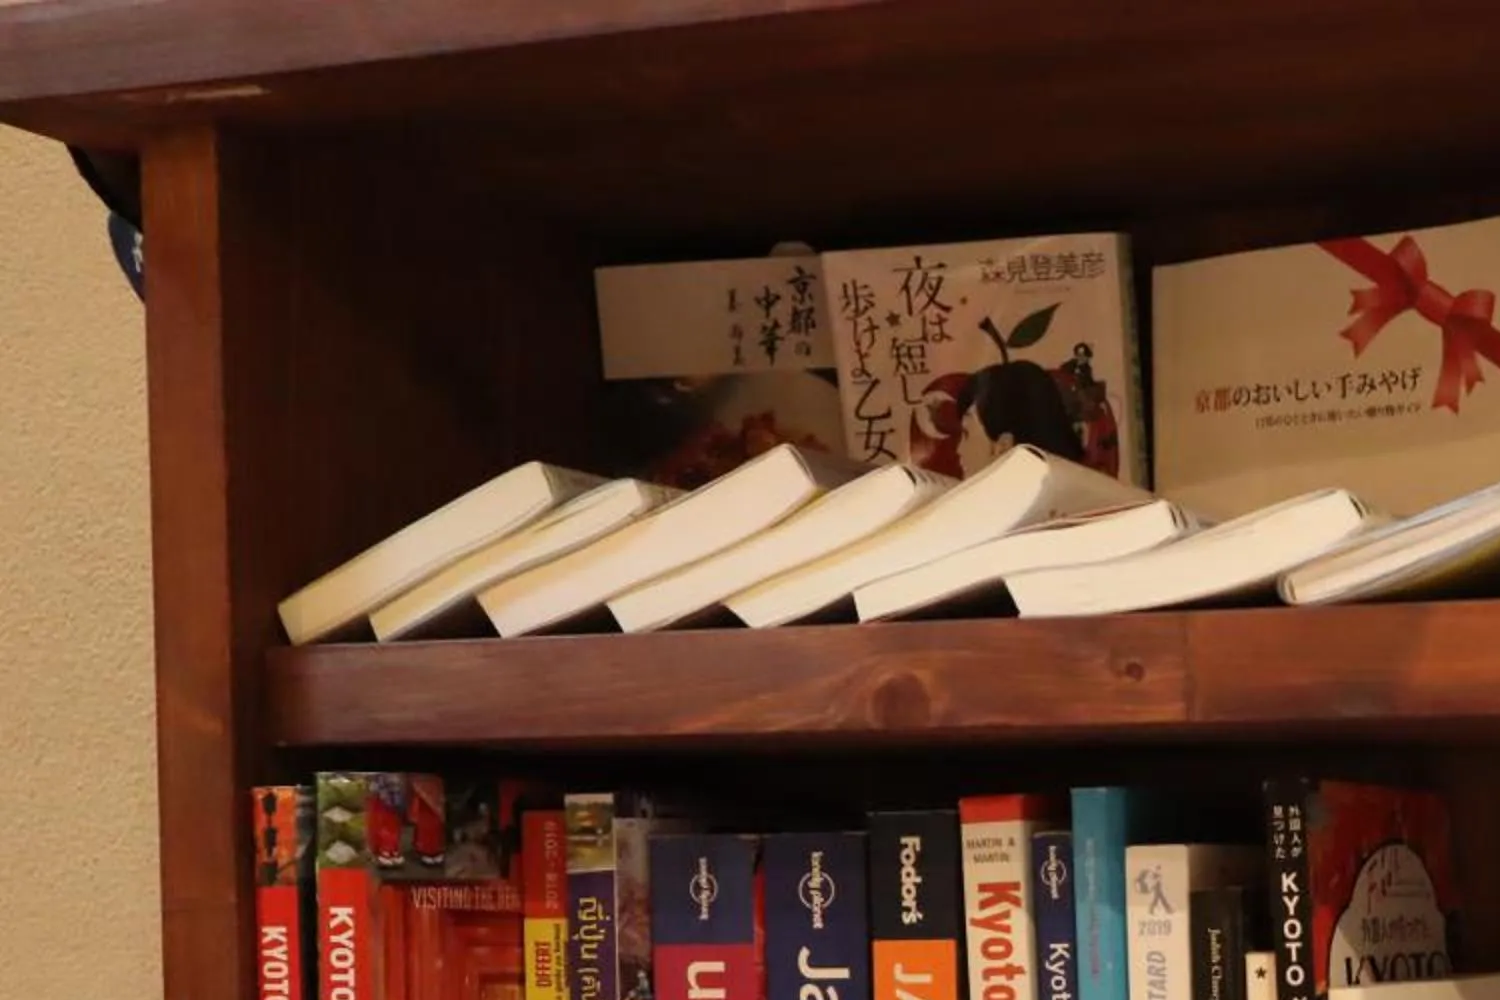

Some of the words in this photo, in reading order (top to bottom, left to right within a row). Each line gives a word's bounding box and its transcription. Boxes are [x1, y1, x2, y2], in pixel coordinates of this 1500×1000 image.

[839, 278, 898, 463] 歩けよ乙女
[889, 255, 955, 408] 夜は短し
[1194, 366, 1423, 415] 京都のおいしい手みやげ
[900, 835, 924, 926] Fodor's
[1281, 871, 1305, 987] KYOTO
